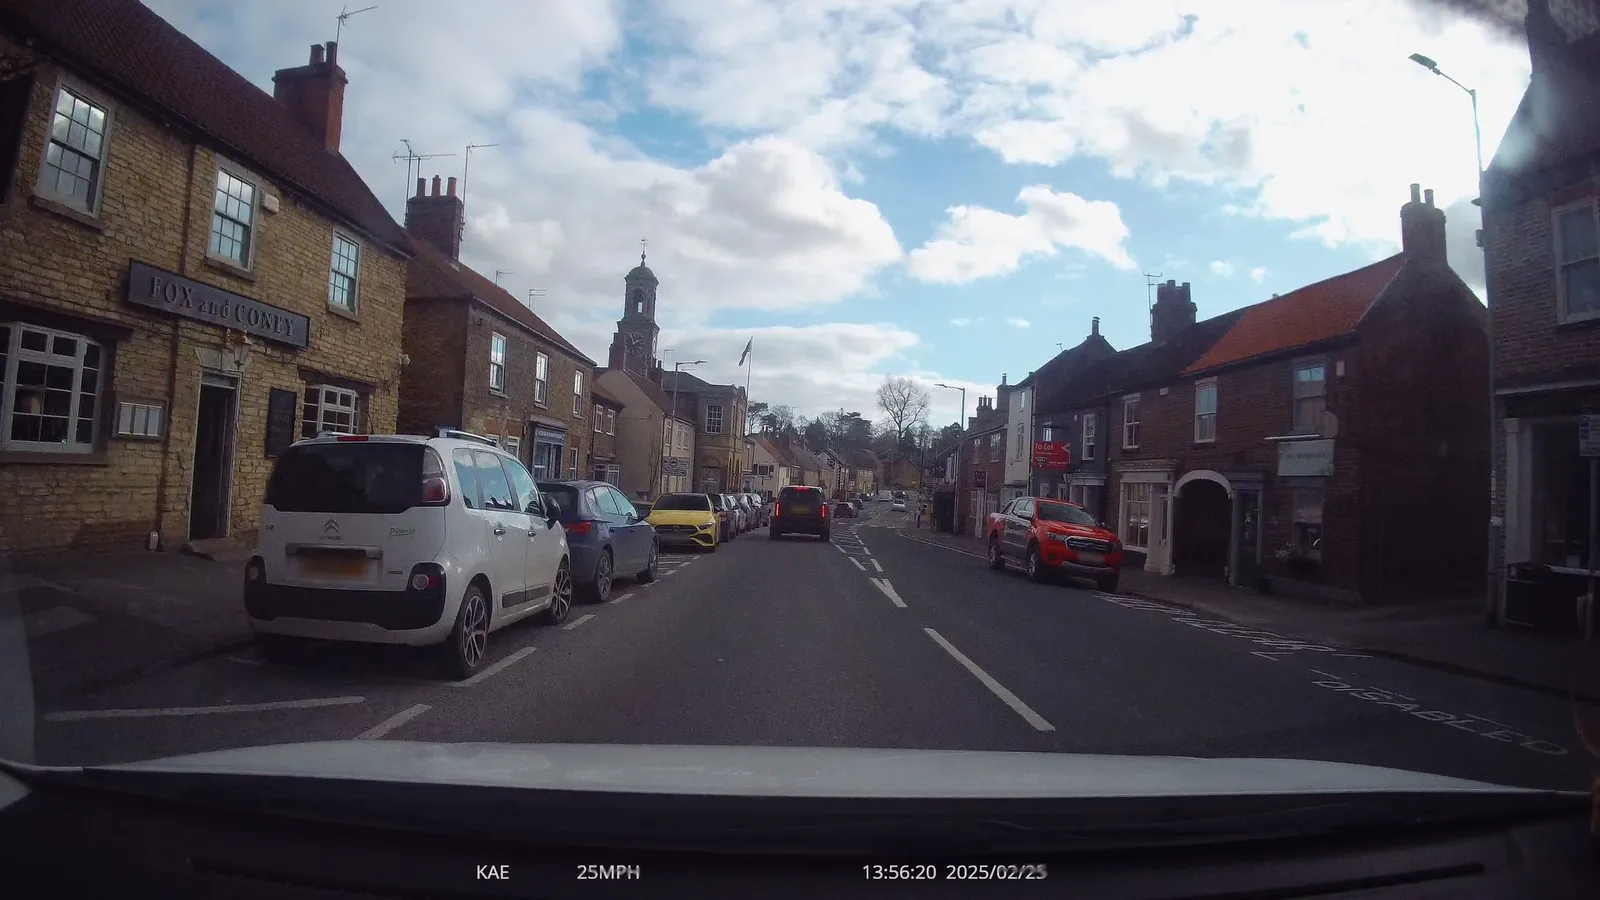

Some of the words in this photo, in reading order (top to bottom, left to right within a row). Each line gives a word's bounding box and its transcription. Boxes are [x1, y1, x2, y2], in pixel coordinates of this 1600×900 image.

[150, 274, 194, 309] FOX
[199, 299, 231, 319] and
[234, 302, 295, 337] CONEY
[1043, 443, 1054, 451] Let
